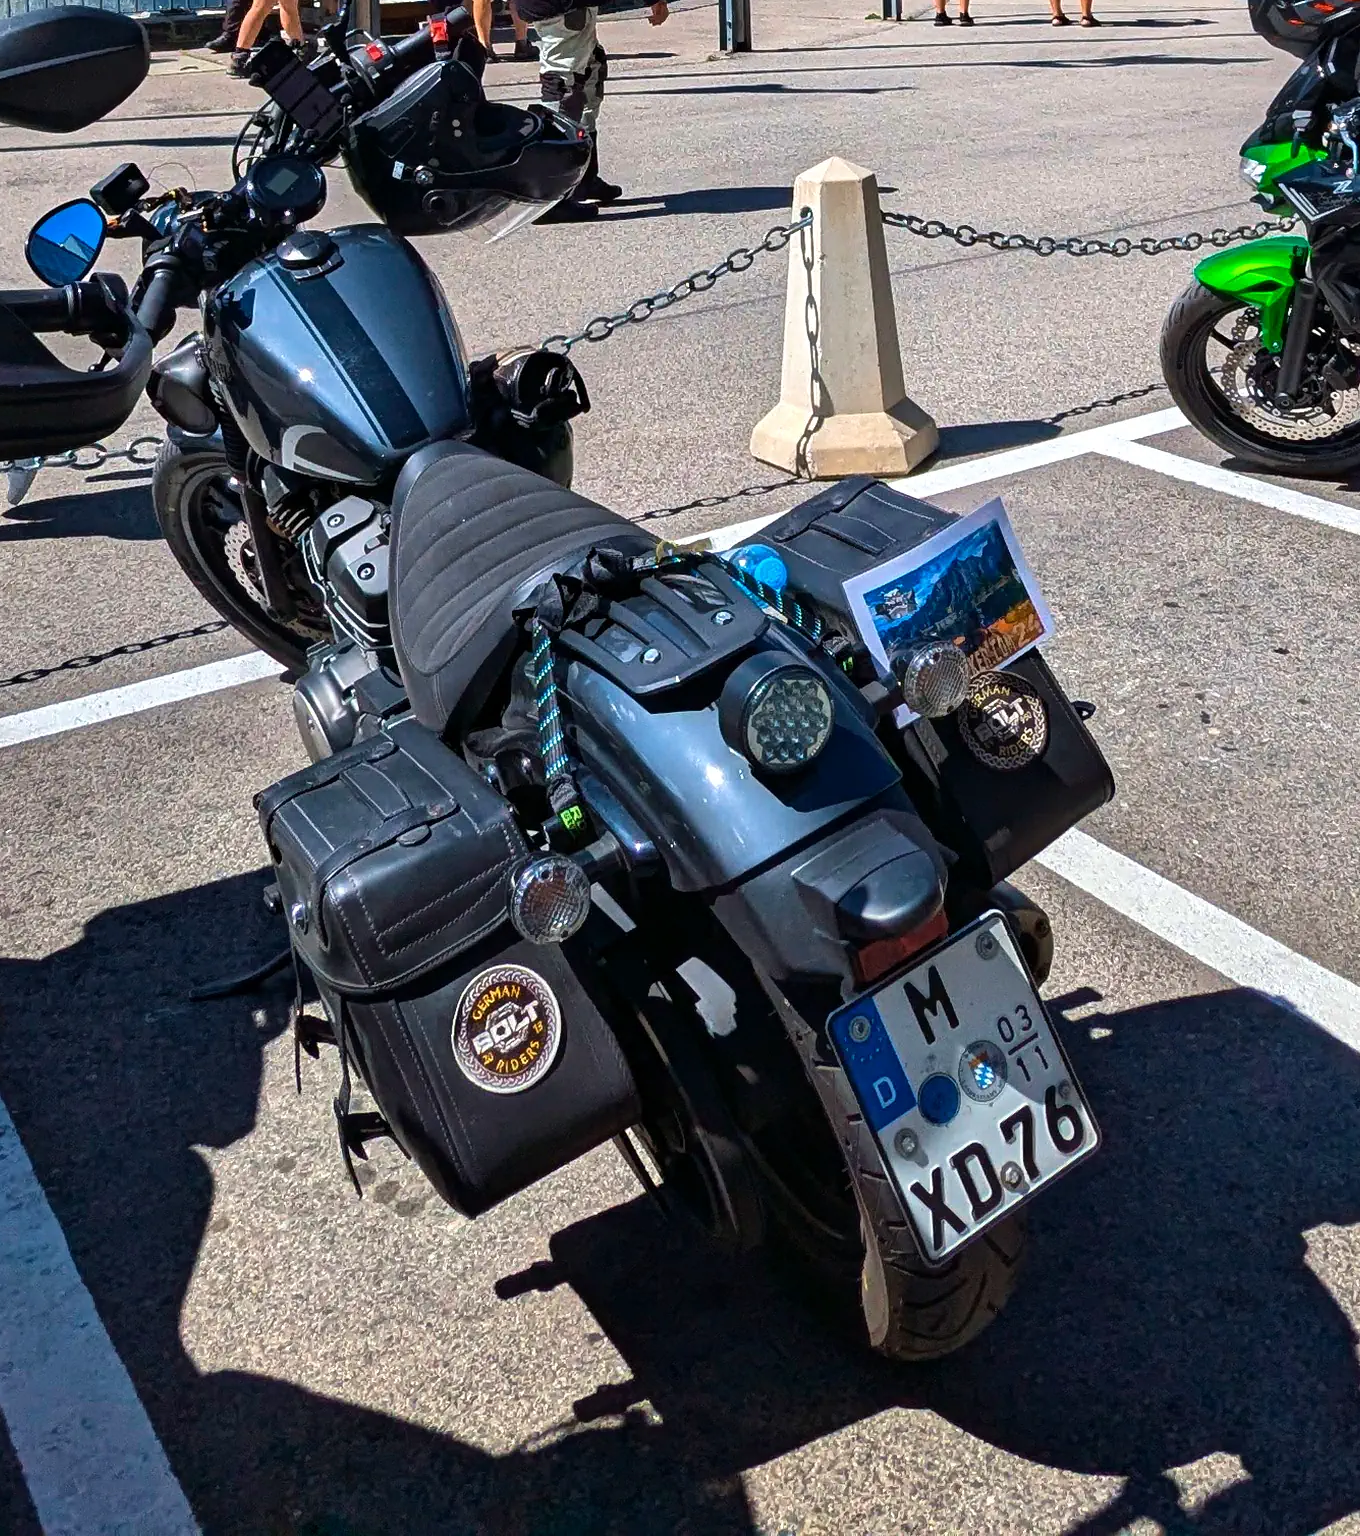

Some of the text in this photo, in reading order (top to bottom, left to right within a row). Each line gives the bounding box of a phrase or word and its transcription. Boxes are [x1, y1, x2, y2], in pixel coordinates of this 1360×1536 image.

[472, 984, 521, 1021] GERMAN
[903, 965, 959, 1045] M
[472, 1000, 538, 1054] BOLT
[997, 1005, 1033, 1043] 03
[495, 1039, 540, 1073] RIDERS
[1016, 1045, 1049, 1082] 11
[873, 1076, 896, 1109] D
[909, 1085, 1085, 1251] XD 76
